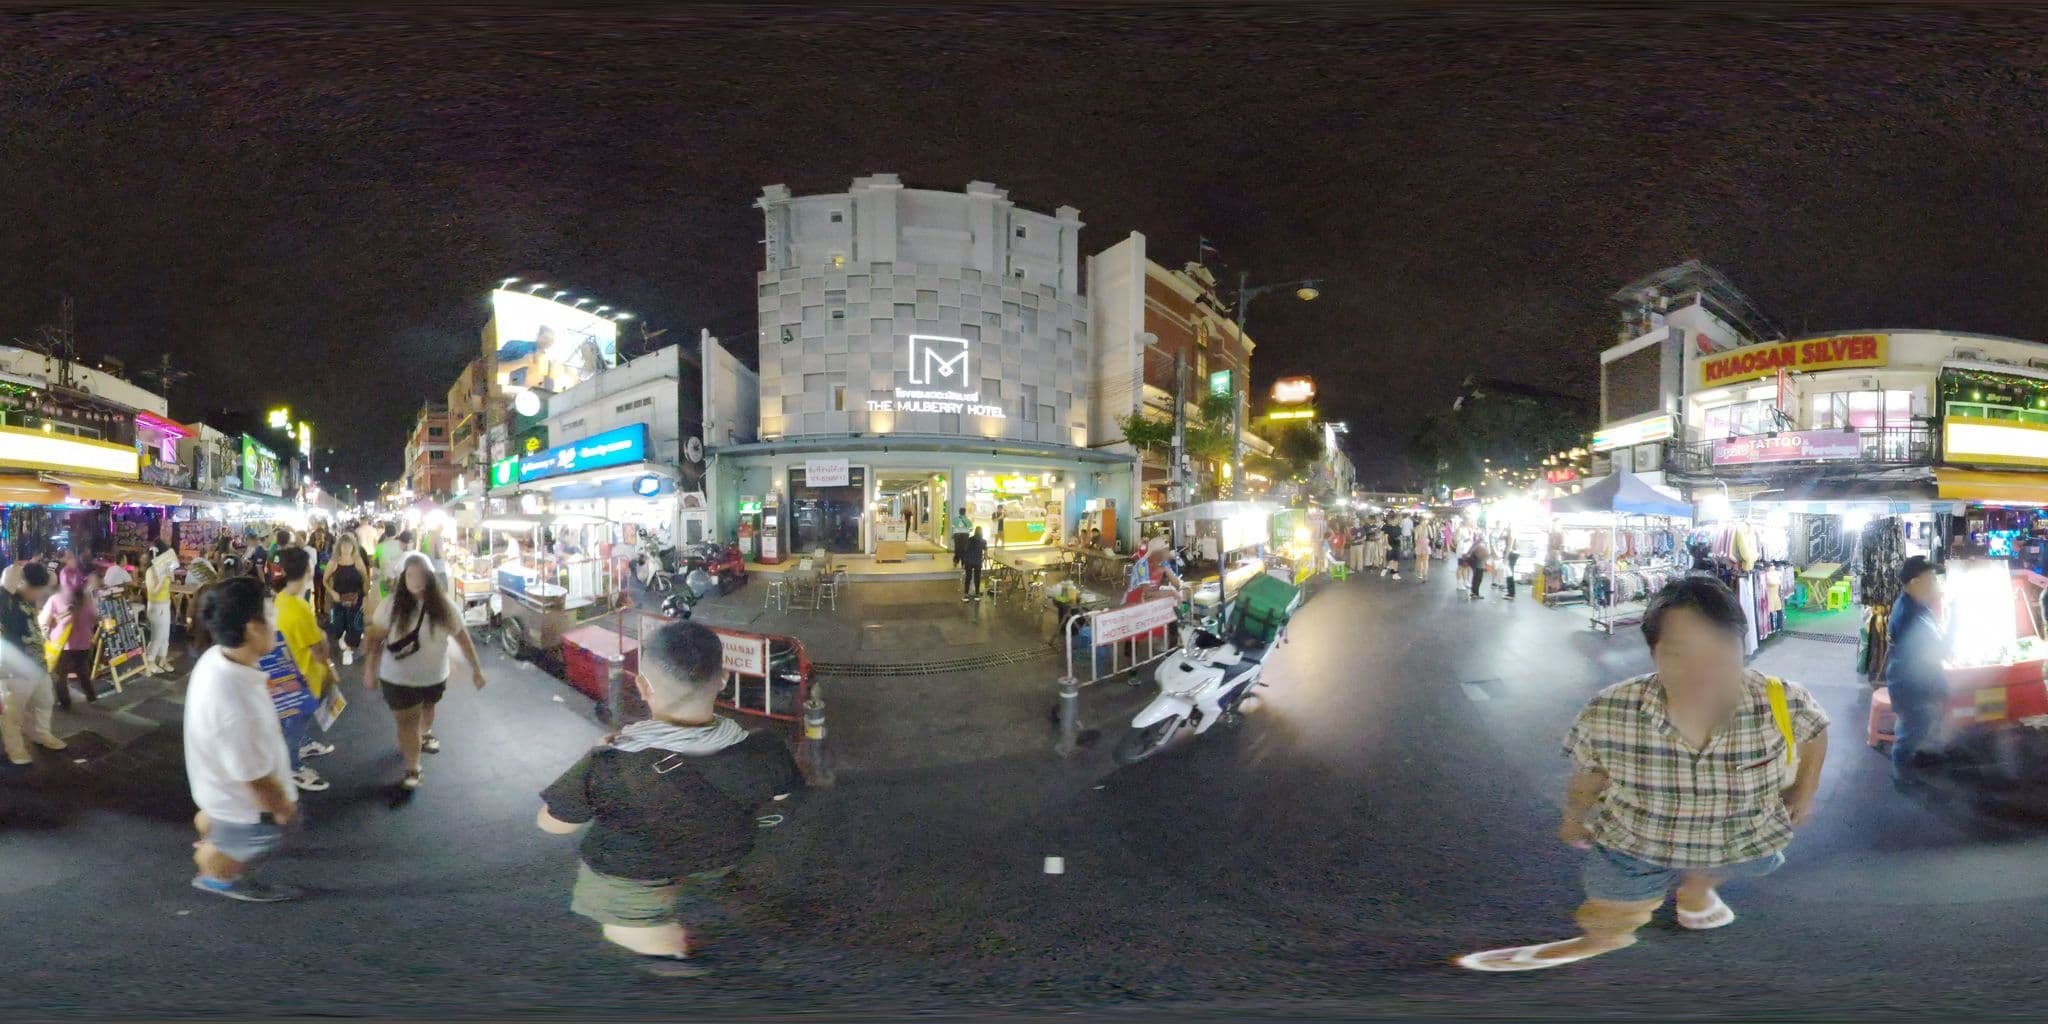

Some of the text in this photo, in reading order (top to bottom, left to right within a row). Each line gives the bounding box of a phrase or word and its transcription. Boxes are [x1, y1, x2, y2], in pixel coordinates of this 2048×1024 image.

[1705, 336, 1877, 381] KHAOSAN SILVER
[867, 400, 1006, 418] THE MULBERRY HOTEL
[1749, 436, 1801, 449] TATTOO
[720, 655, 753, 668] NCE
